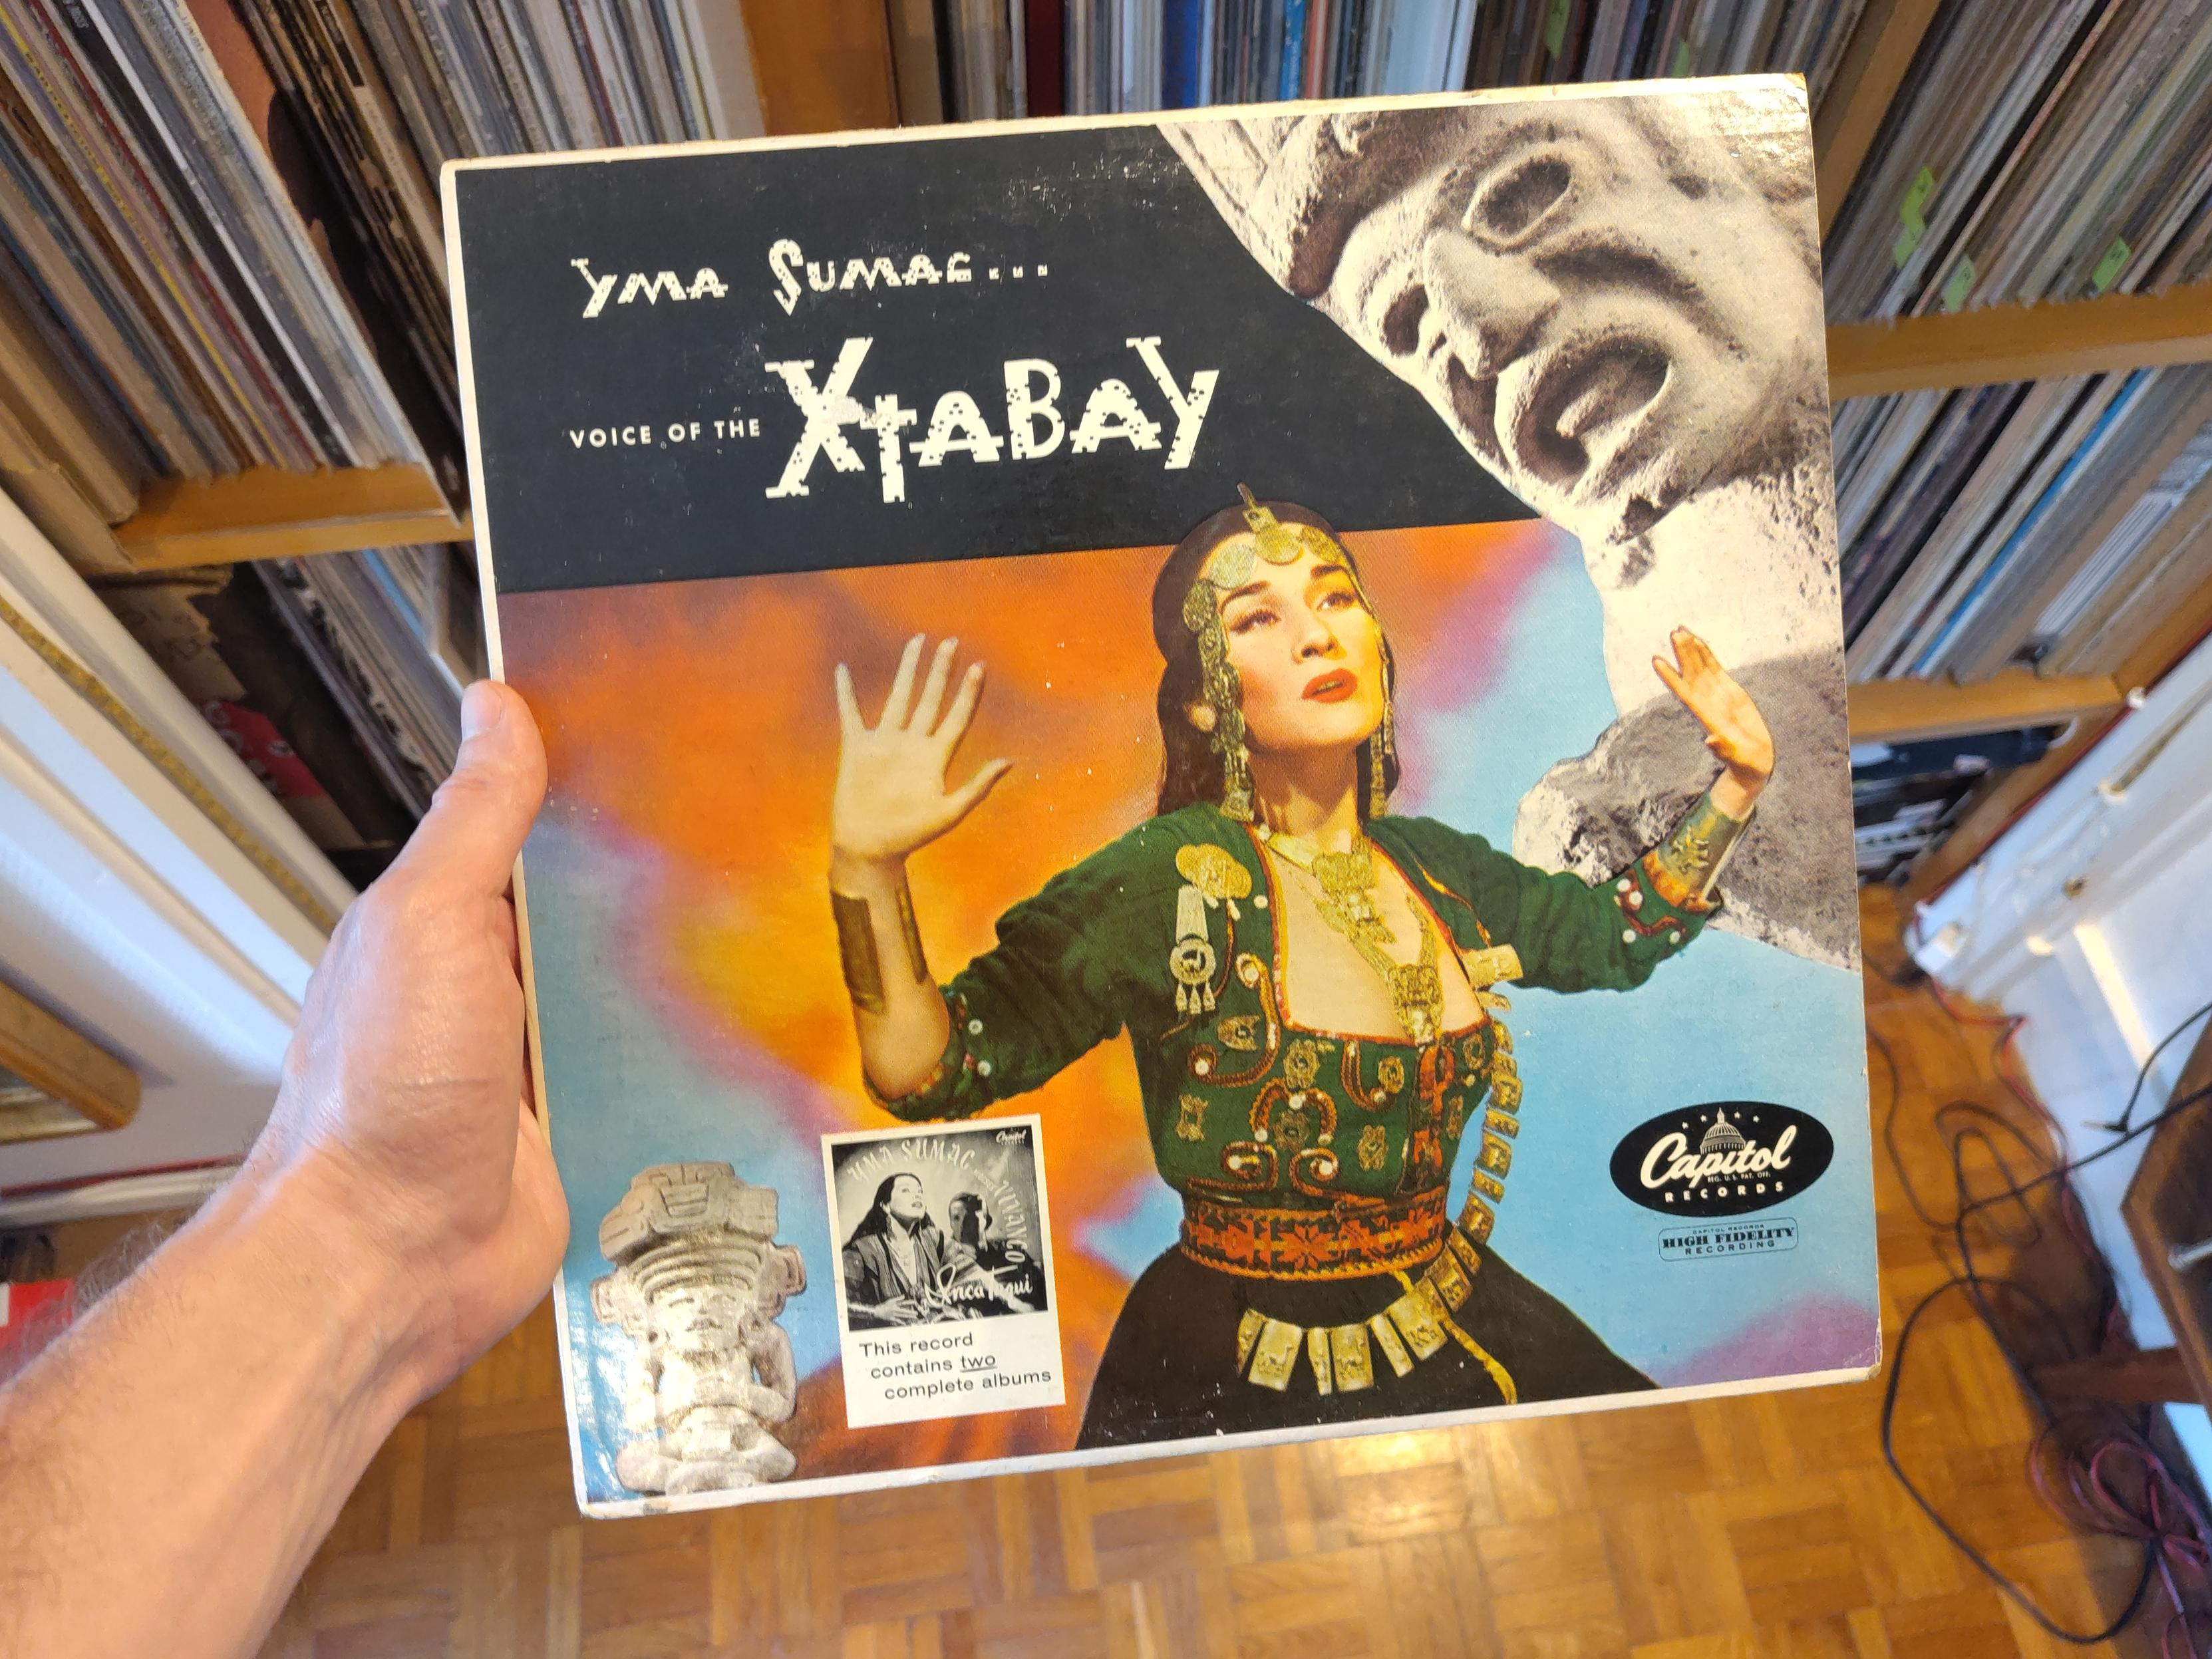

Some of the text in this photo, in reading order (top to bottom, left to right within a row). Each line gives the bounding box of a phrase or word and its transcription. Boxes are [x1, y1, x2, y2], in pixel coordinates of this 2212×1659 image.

[569, 425, 651, 448] VOICE
[668, 422, 701, 443] OF
[714, 418, 760, 439] THE
[847, 1138, 976, 1183] YMA SUMAC
[1640, 1124, 1798, 1189] Capitol
[1664, 1181, 1784, 1203] RECORDS
[1662, 1228, 1795, 1249] HIGH FIDELITY
[1684, 1240, 1776, 1256] RECORDING
[859, 1331, 973, 1358] This record
[870, 1354, 997, 1380] contains two
[884, 1370, 1052, 1400] complete albums
